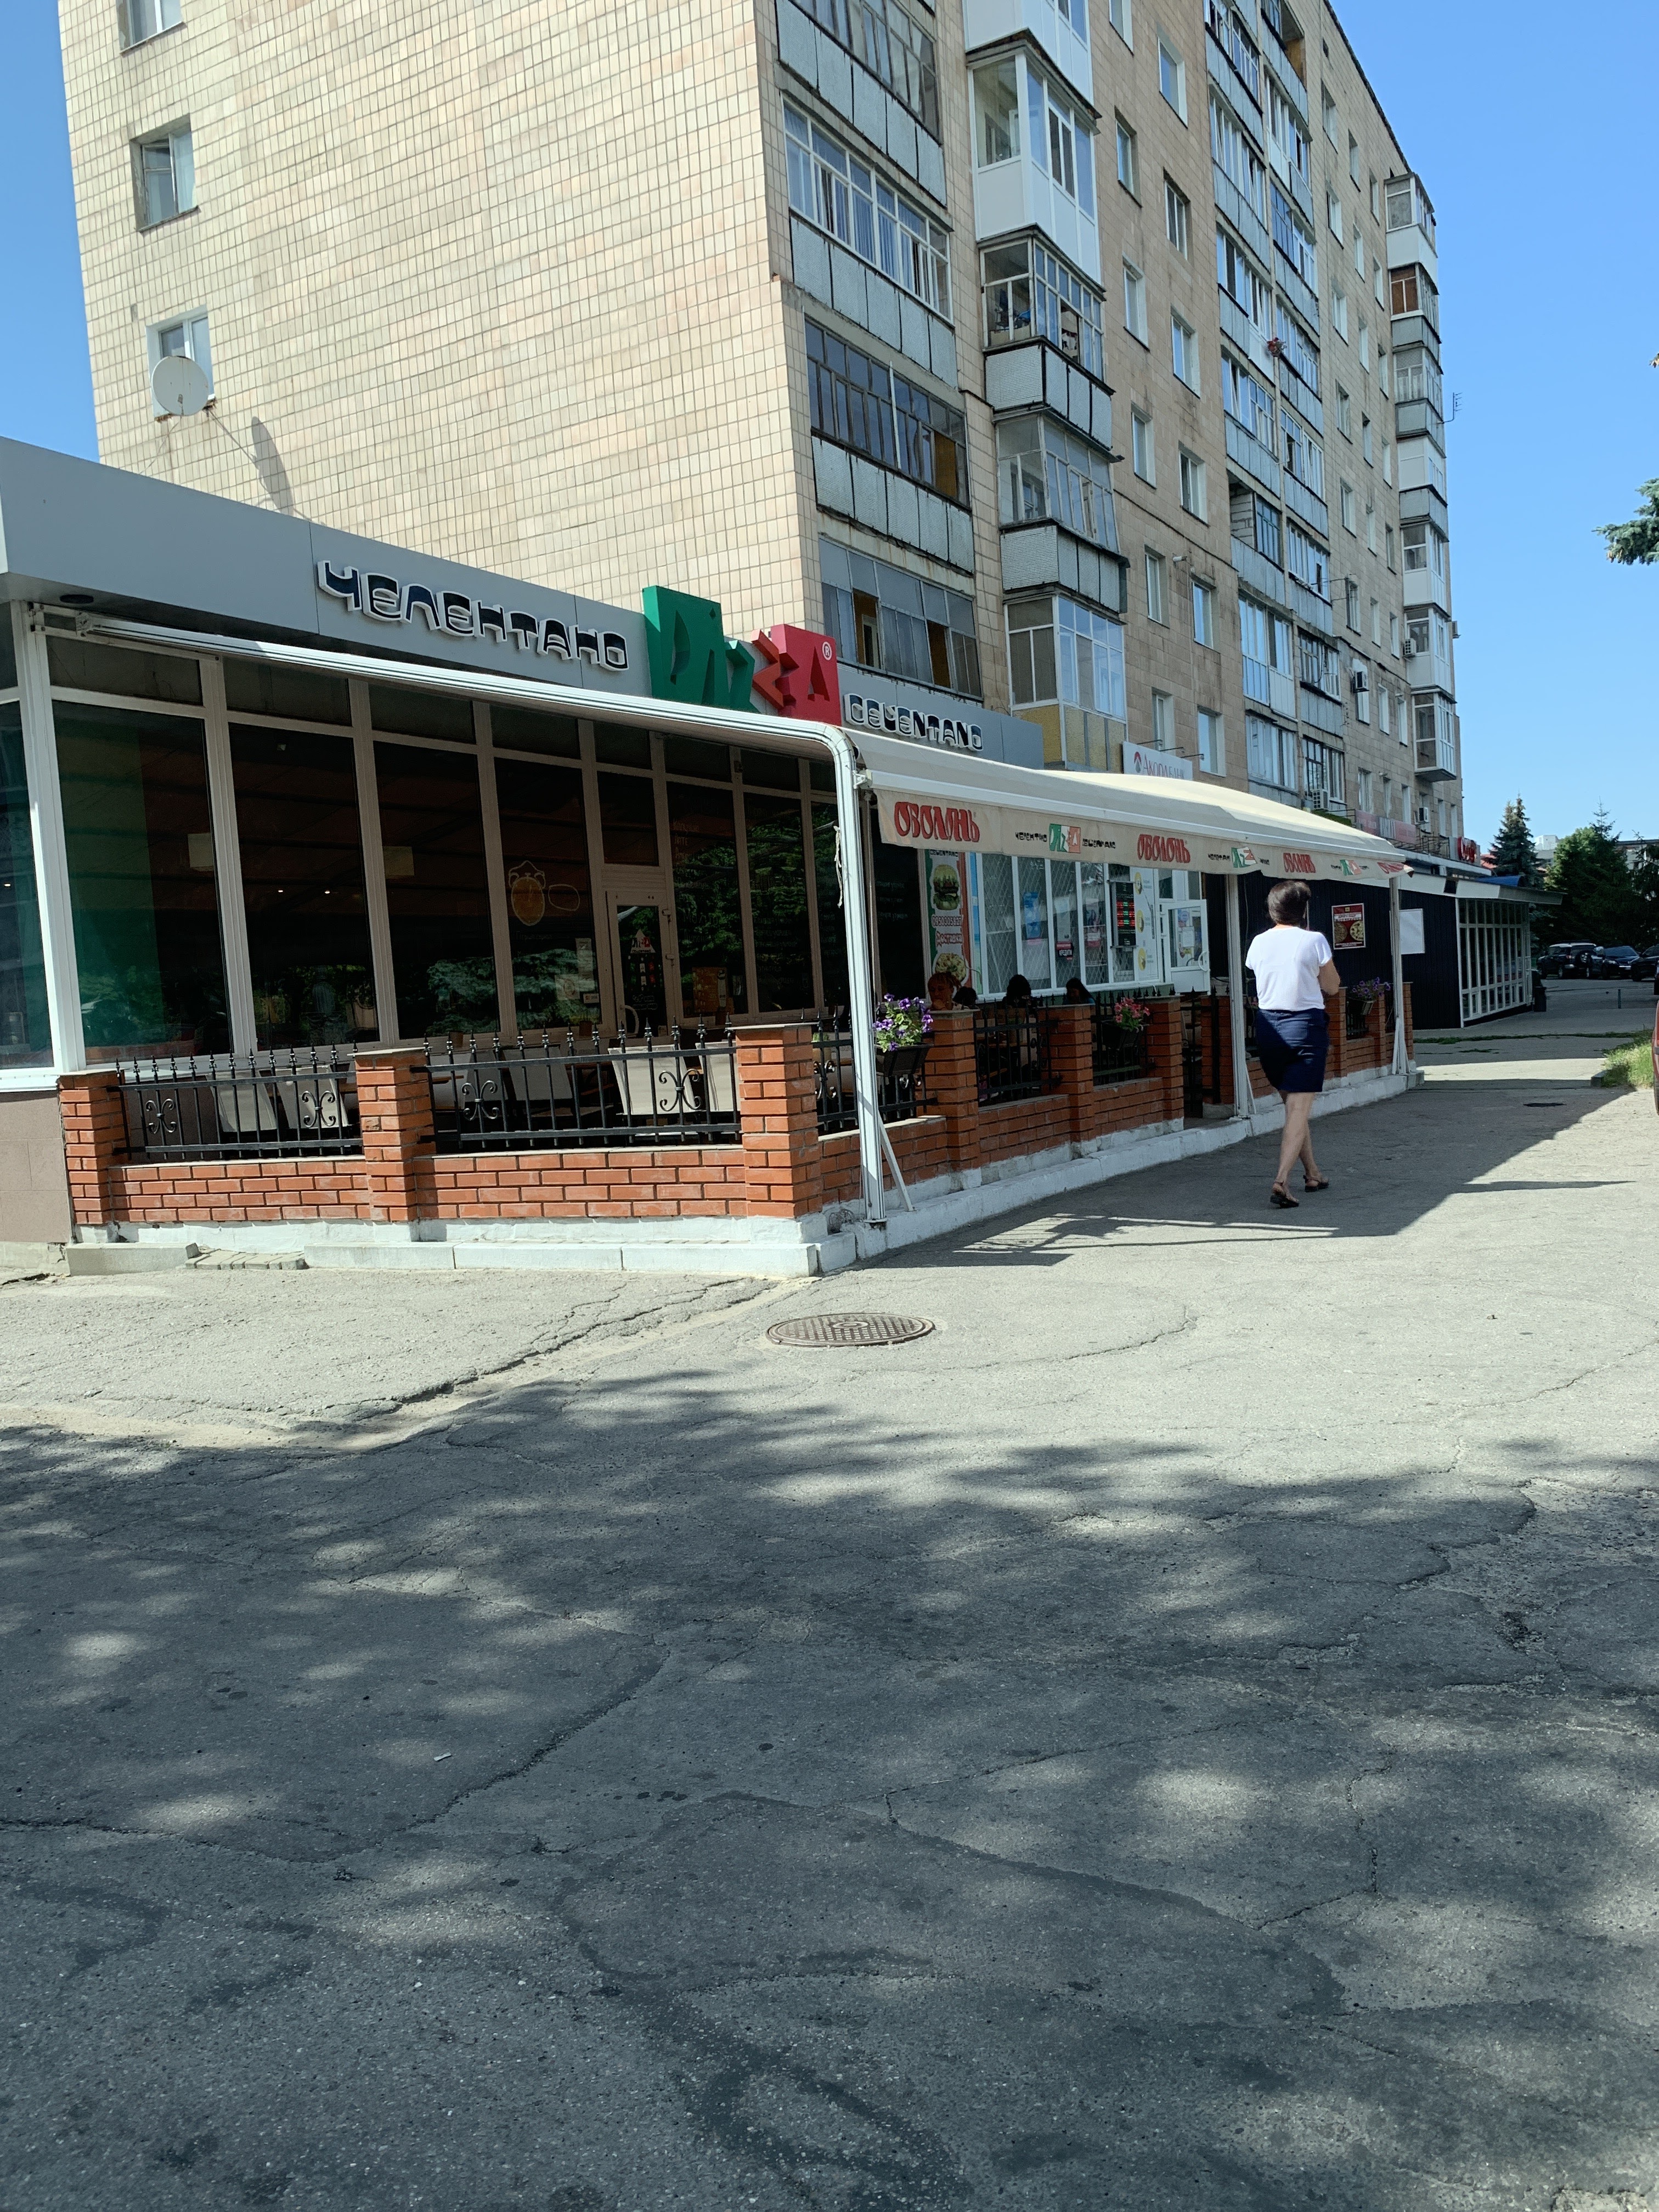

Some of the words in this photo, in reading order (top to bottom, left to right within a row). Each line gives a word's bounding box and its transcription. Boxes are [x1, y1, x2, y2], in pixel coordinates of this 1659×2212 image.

[318, 560, 629, 672] ЧЕЛЕНТАНО
[845, 693, 983, 751] CELENTANO
[1137, 833, 1190, 864] ОБОЛОНЬ
